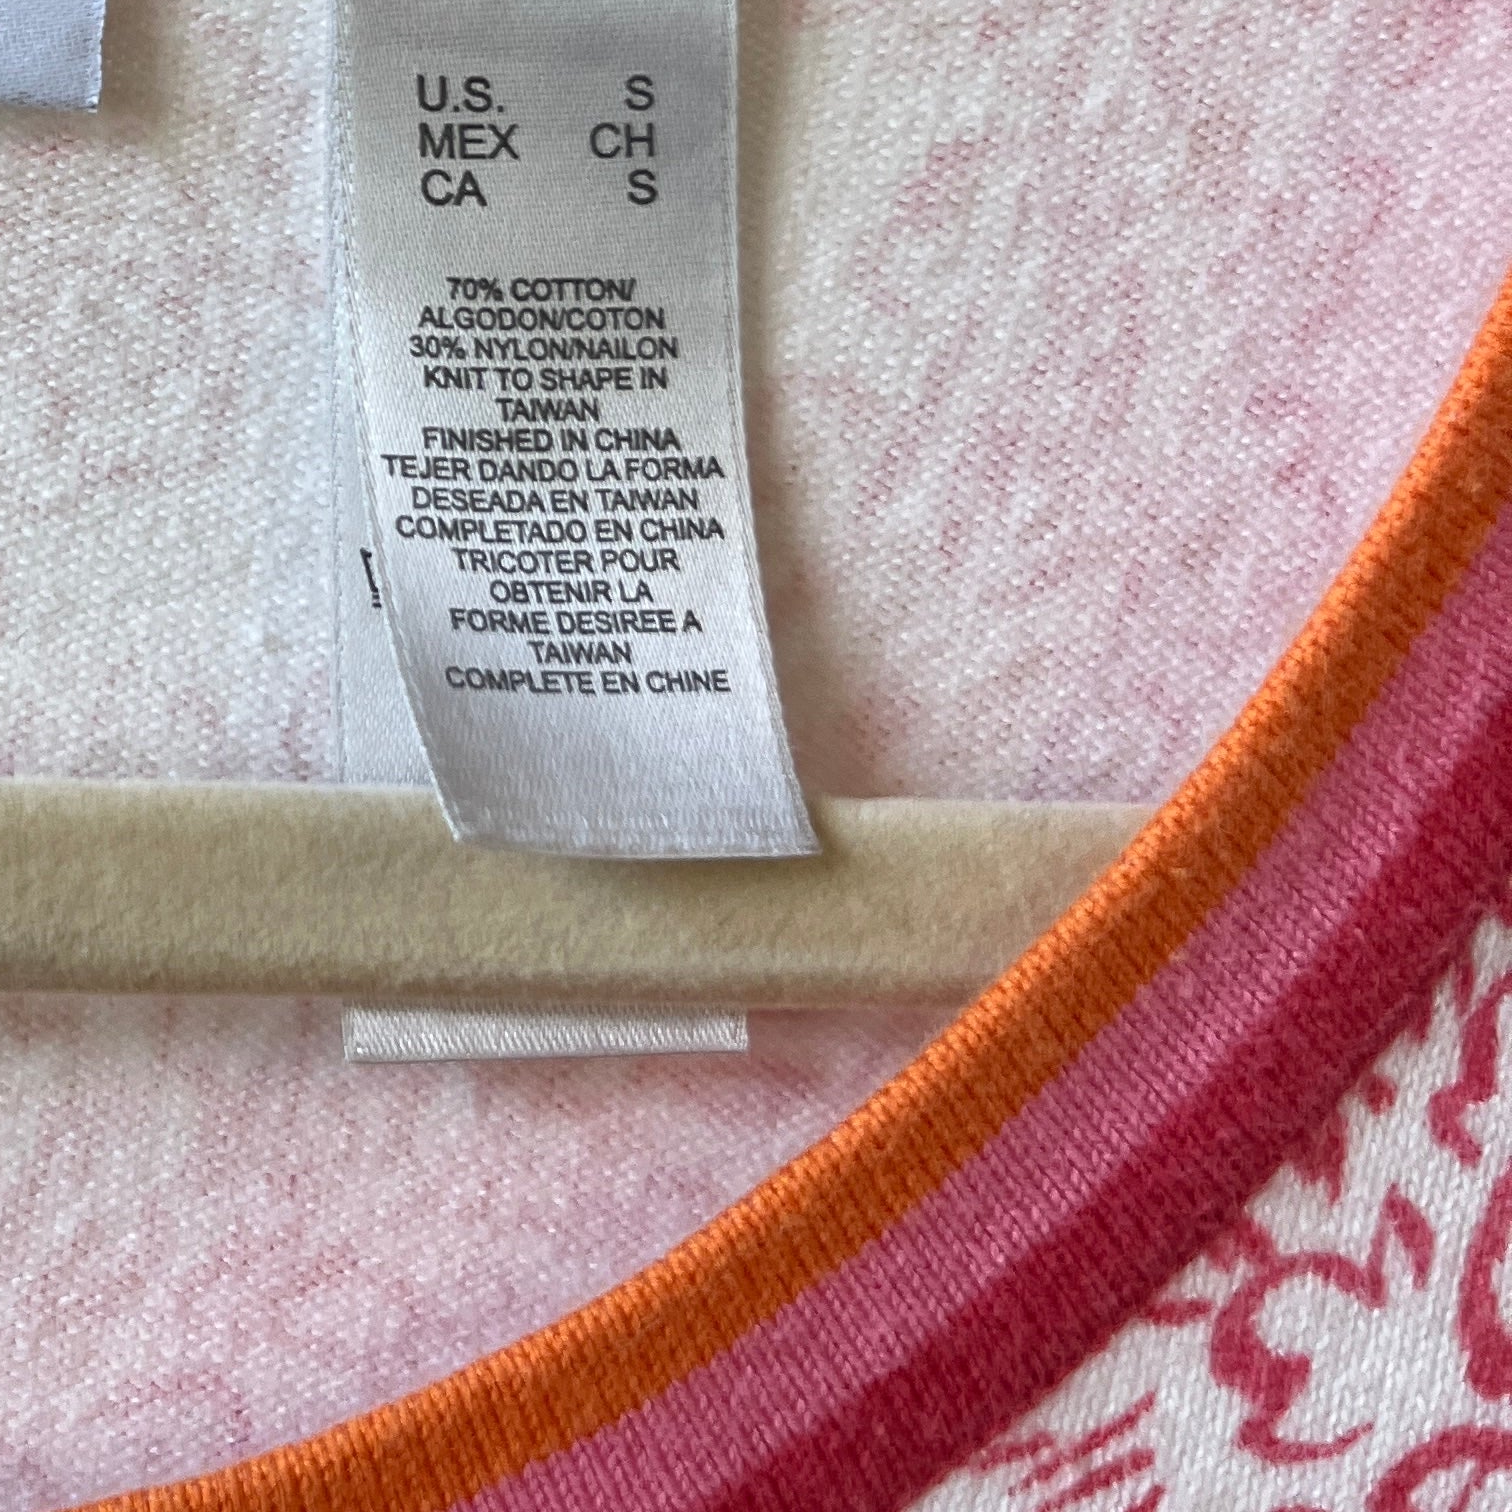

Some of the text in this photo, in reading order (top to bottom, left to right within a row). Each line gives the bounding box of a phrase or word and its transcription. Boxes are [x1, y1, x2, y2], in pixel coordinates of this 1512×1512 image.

[416, 74, 654, 113] U.S. S
[418, 122, 655, 160] MEX CH
[420, 169, 658, 206] CA S
[446, 277, 636, 302] 70% COTTON/
[418, 306, 664, 331] ALGODON/COTON
[409, 335, 678, 360] 30% NYLON/NAILON
[423, 365, 667, 390] KNIT TO SHAPE IN
[495, 398, 599, 422] TAIWAN
[423, 428, 681, 452] FINISHED IN CHINA
[381, 455, 725, 482] TEJER DANDO LA FORMA
[413, 487, 698, 512] DESEADA EN TAIWAN
[395, 516, 725, 543] COMPLETADO EN CHINA
[453, 547, 679, 573] TRICOTER POUR
[489, 579, 653, 603] OBTENIR LA
[450, 608, 703, 634] FORME DESIREE A
[527, 640, 632, 664] TAIWAN
[445, 666, 731, 694] COMPLETE EN CHINE
